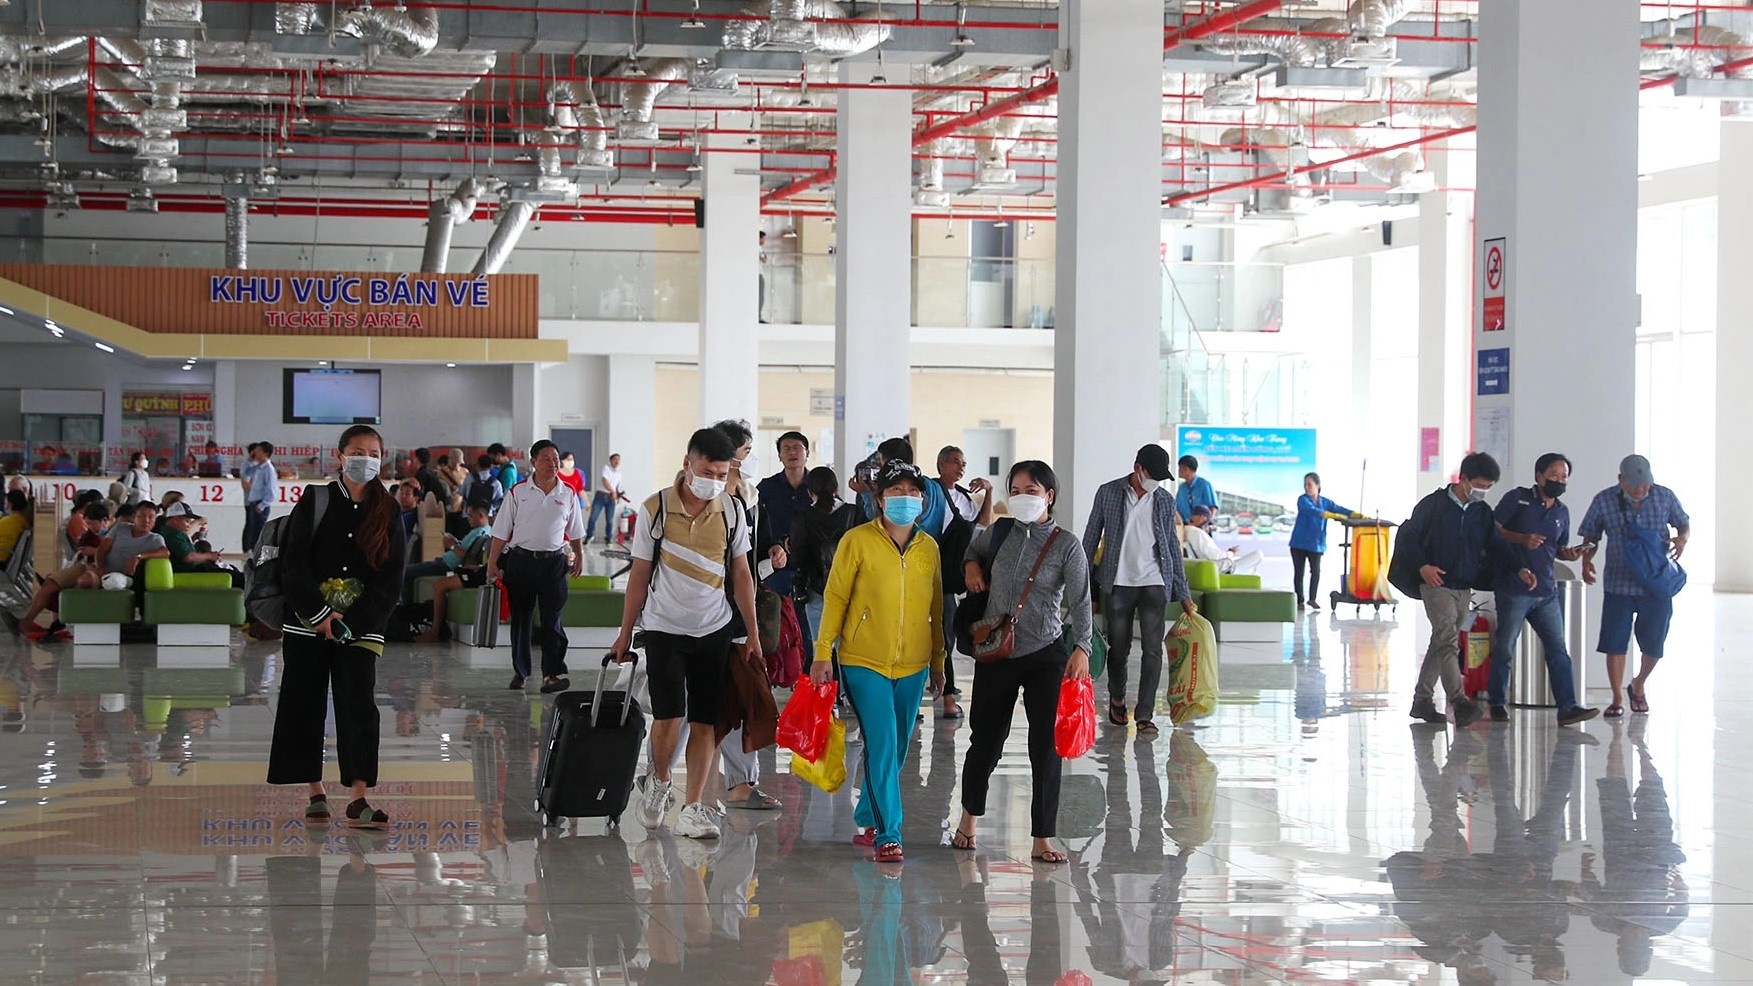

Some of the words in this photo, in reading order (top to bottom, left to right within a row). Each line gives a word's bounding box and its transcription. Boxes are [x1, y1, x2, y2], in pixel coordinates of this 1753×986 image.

[211, 276, 282, 302] KHU
[291, 275, 362, 311] VỰC
[369, 273, 437, 306] BÁN
[446, 274, 489, 307] VÉ
[265, 311, 356, 328] TICKETS
[362, 312, 422, 329] AREA
[274, 446, 287, 456] HI
[52, 483, 76, 500] 10
[200, 485, 224, 502] 12
[278, 485, 302, 503] 13
